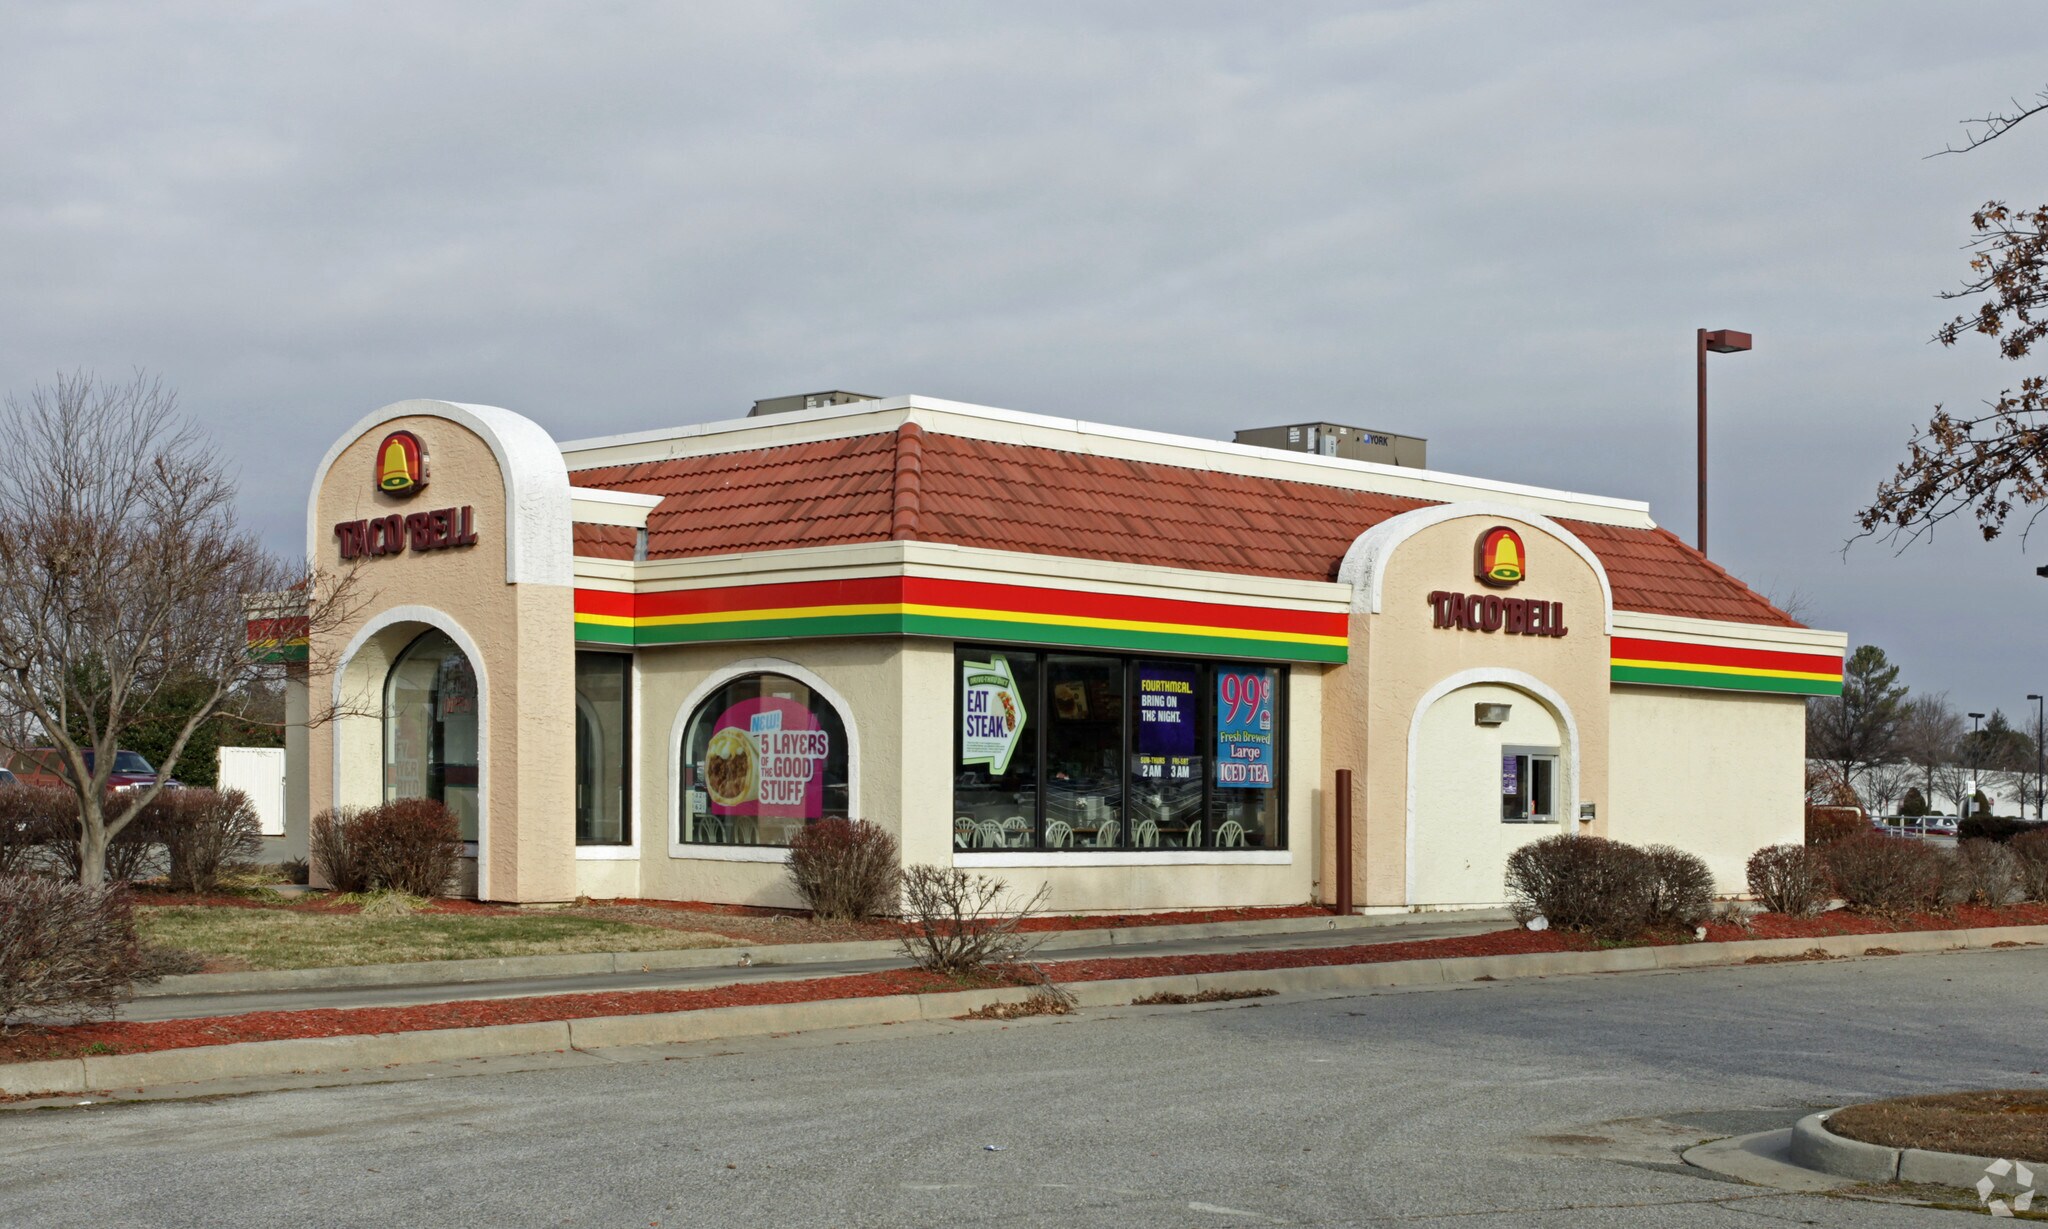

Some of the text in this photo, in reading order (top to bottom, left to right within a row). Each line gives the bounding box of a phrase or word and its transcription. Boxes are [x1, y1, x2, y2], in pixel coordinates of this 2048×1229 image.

[1370, 435, 1388, 447] YORK
[334, 505, 478, 560] TACO BELL
[1428, 590, 1568, 639] TACO BELL
[1141, 680, 1193, 694] FOURTHMEAL.
[967, 690, 989, 713] EAT
[1141, 695, 1177, 708] BRING ON
[752, 713, 780, 732] NEW!
[1142, 710, 1181, 723] THE NIGHT.
[966, 715, 1008, 739] STEAK.
[761, 733, 827, 756] 5 LAYERS
[1220, 731, 1270, 745] Fresh Brewed
[1230, 744, 1261, 762] Large
[761, 757, 811, 778] OF GOOD
[761, 768, 773, 777] THE
[1220, 763, 1270, 783] ICED TEA
[761, 780, 803, 801] STUFF
